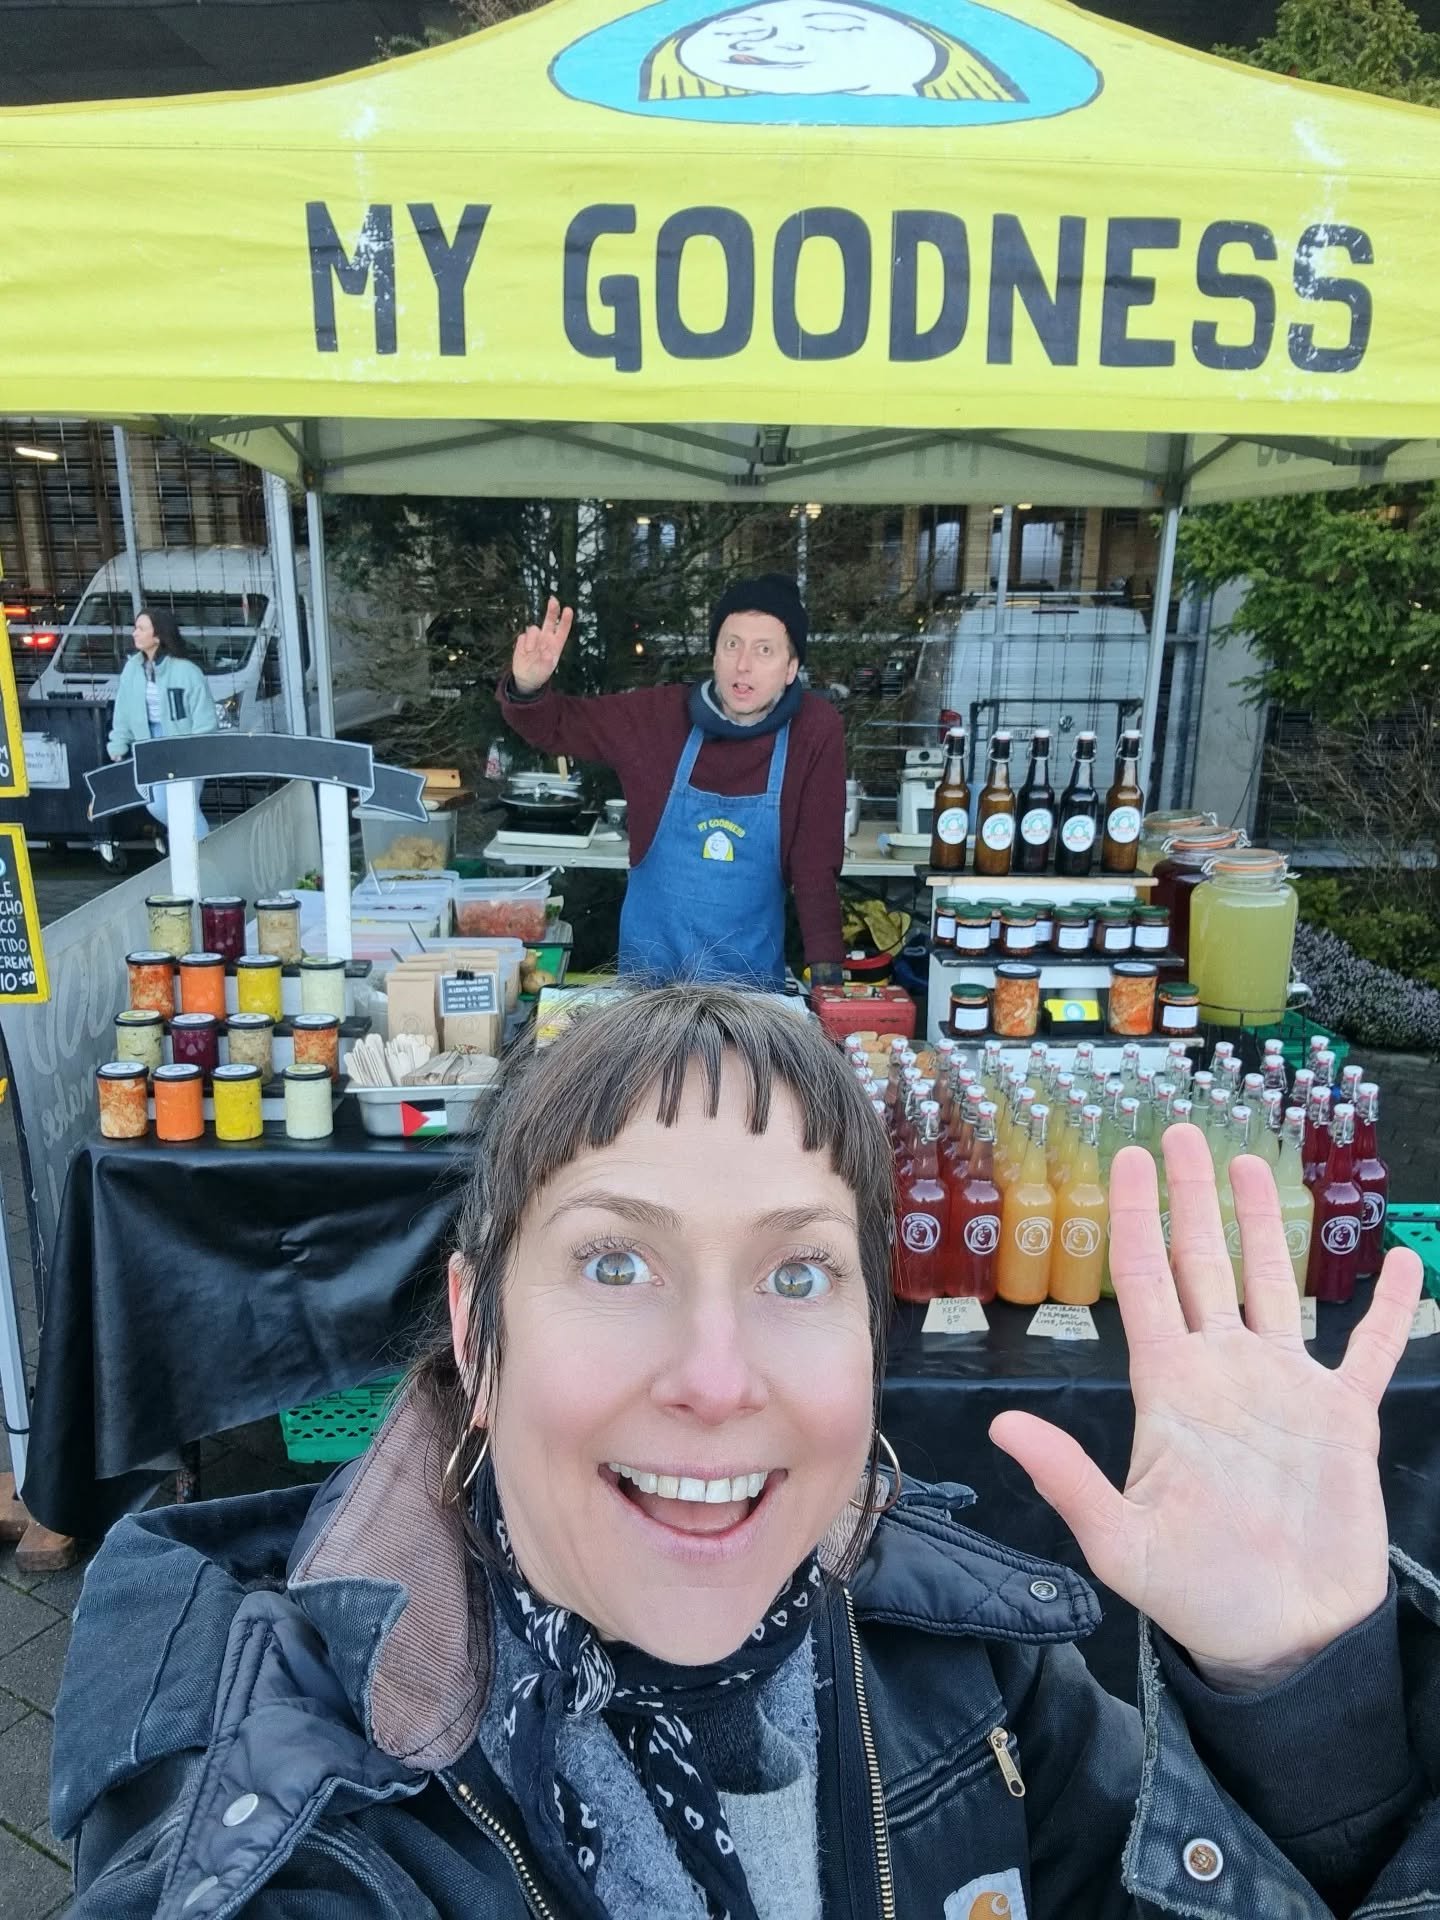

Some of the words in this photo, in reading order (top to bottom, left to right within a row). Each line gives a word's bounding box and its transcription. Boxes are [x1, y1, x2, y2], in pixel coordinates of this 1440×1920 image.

[306, 201, 492, 357] MY
[563, 202, 1374, 373] GOODNESS
[942, 1305, 968, 1314] KEFIR
